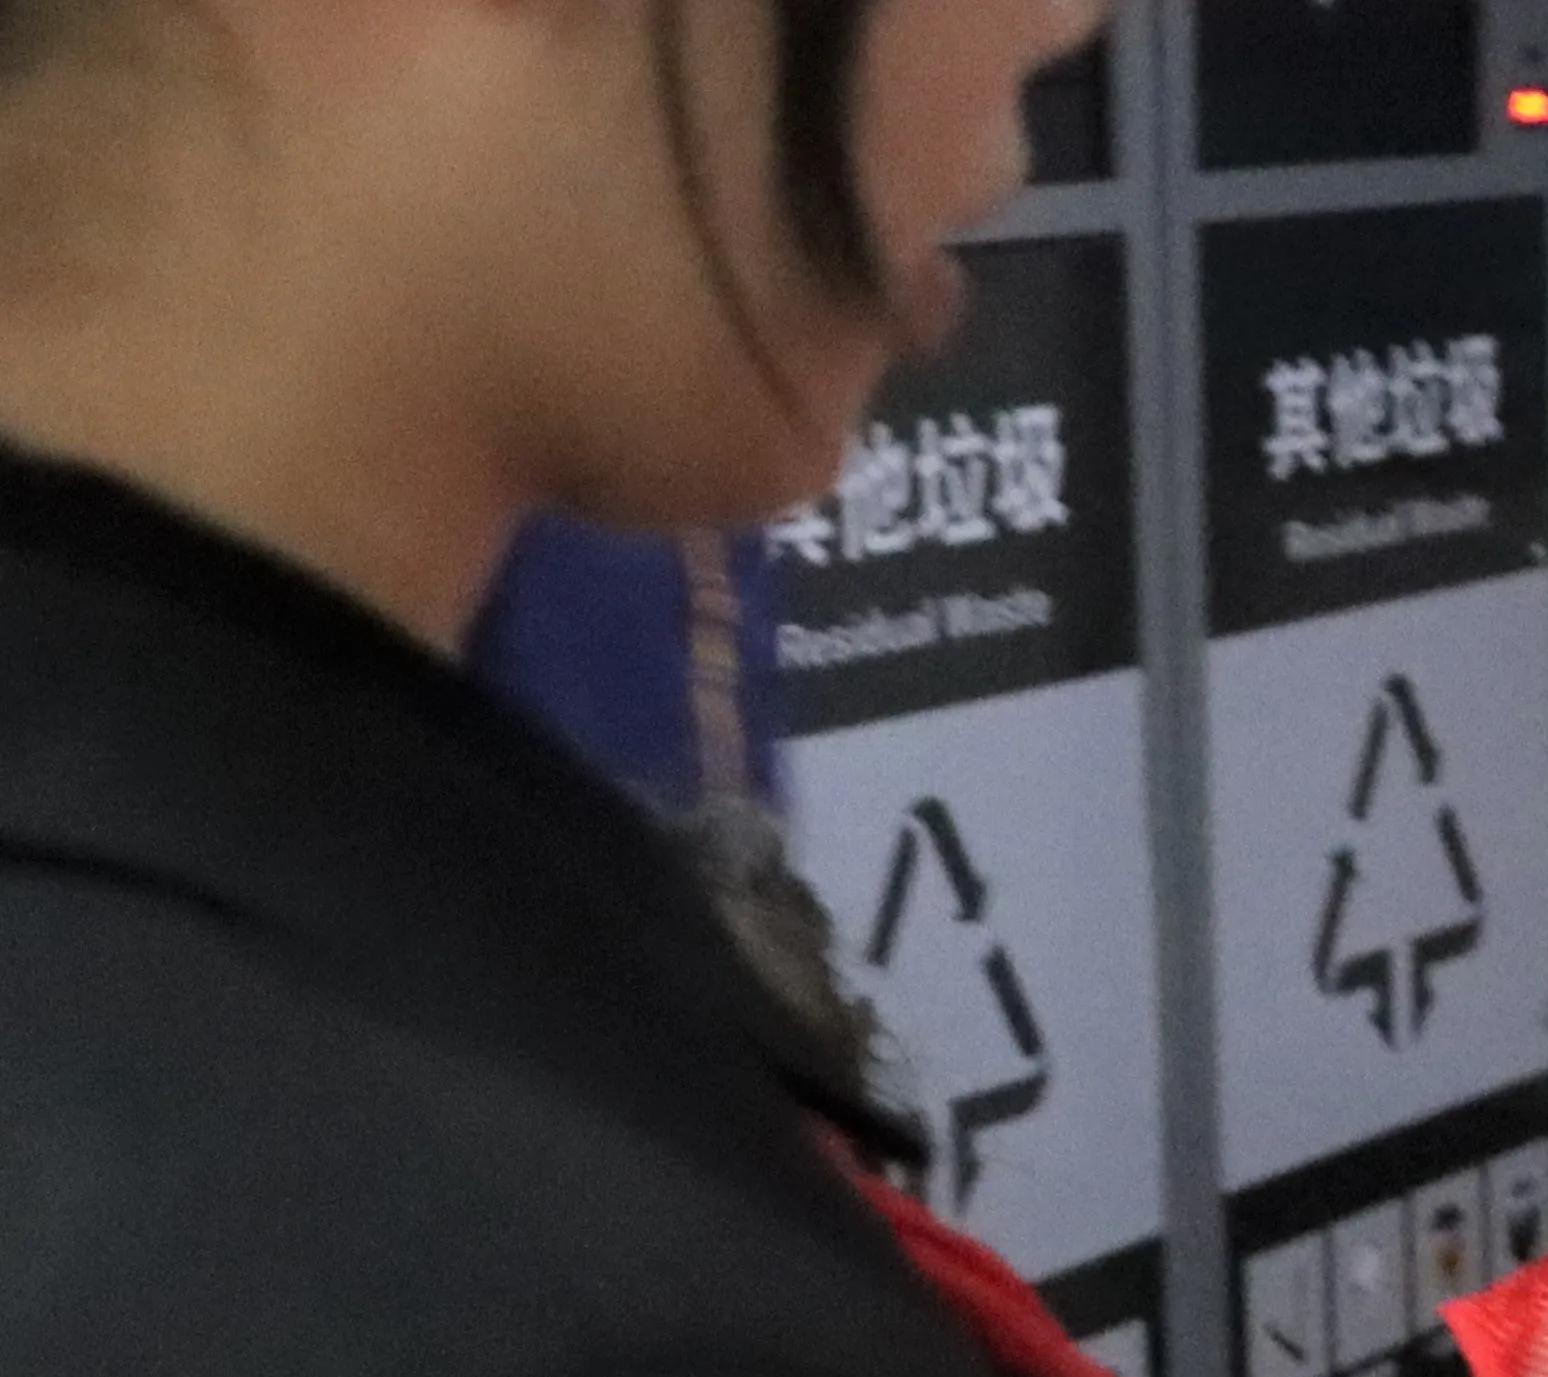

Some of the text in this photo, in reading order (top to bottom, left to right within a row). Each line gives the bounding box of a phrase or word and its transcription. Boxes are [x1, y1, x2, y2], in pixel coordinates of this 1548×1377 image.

[1262, 334, 1503, 481] 其他垃圾
[776, 587, 1052, 670] Residual Waste
